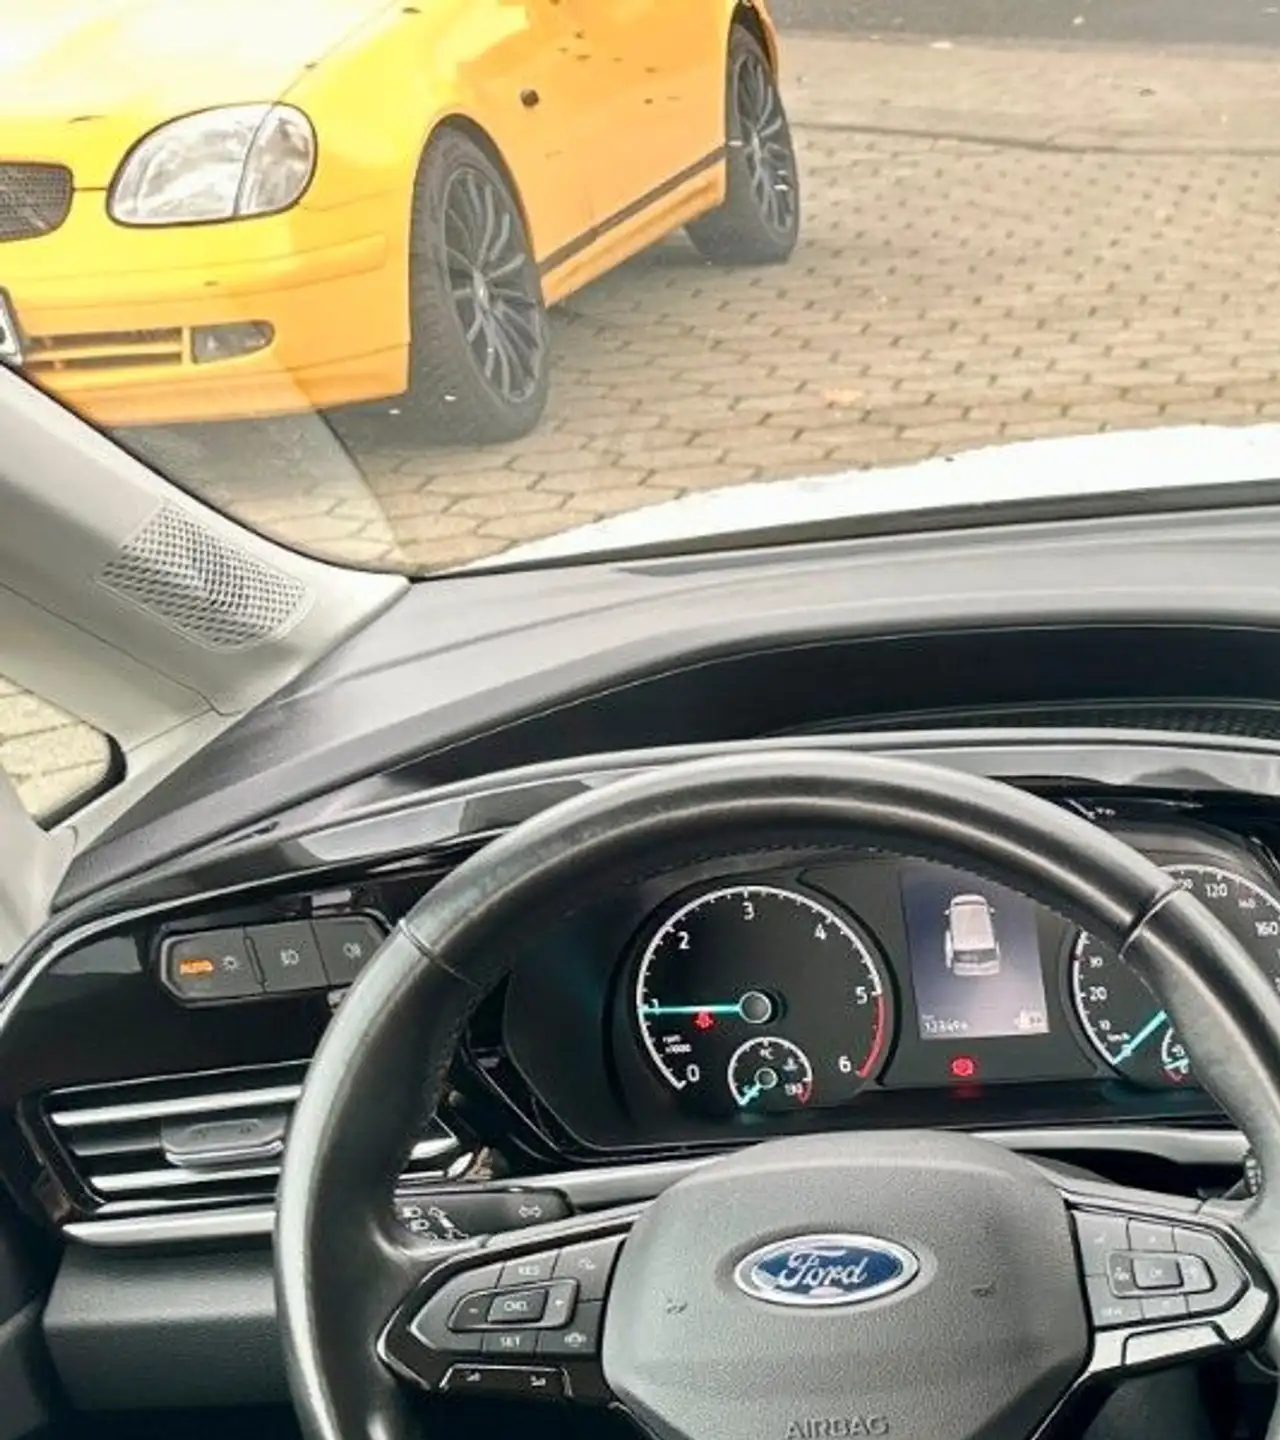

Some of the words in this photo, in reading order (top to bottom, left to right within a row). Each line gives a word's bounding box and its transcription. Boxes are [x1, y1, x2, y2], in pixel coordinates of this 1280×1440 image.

[1205, 883, 1229, 898] 120
[742, 902, 755, 920] 3
[814, 923, 828, 941] 4
[1255, 920, 1279, 937] 160
[678, 931, 691, 950] 2
[856, 986, 868, 1005] 5
[1089, 986, 1108, 1002] 20
[685, 1063, 701, 1082] 0
[838, 1056, 852, 1074] 6
[778, 1246, 869, 1289] Ford
[786, 1415, 890, 1440] AIRBAG
